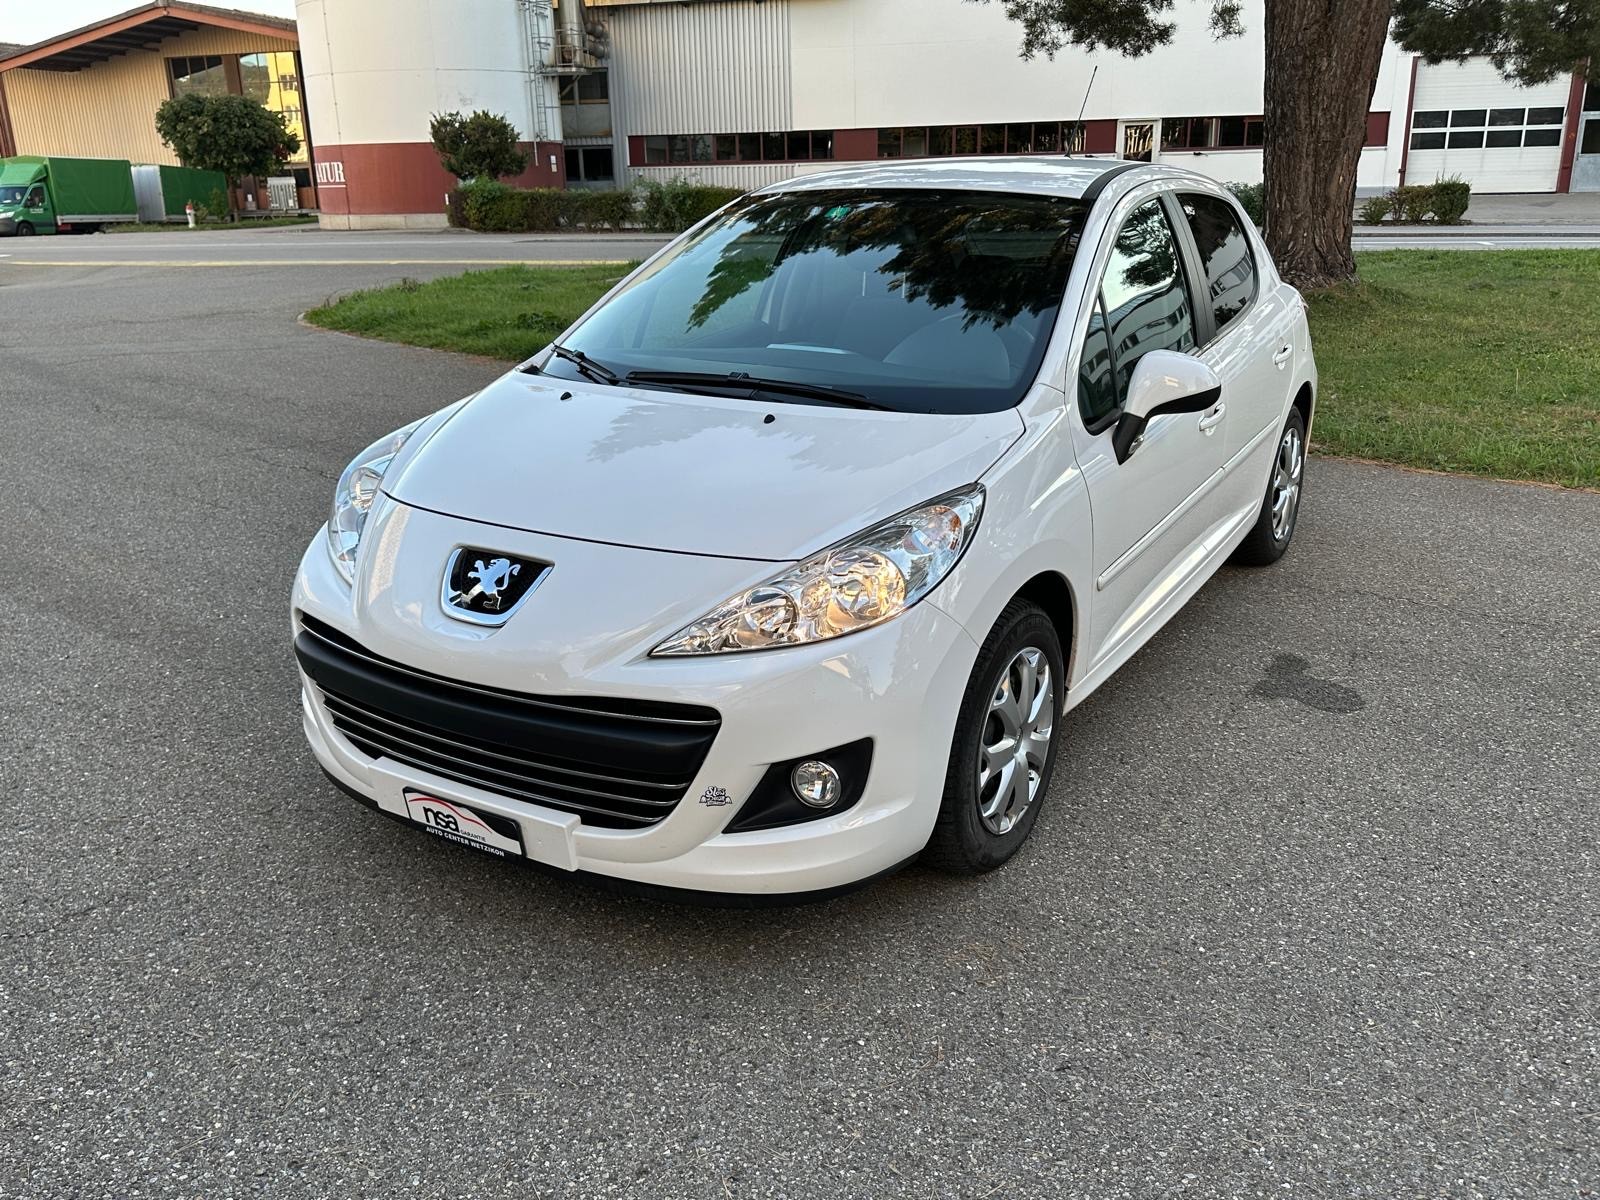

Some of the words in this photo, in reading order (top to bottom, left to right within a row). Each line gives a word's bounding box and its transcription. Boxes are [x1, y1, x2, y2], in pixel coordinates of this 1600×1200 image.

[422, 805, 460, 833] nsa
[426, 826, 443, 836] AUTO
[444, 833, 470, 845] CENTER
[470, 841, 505, 857] WETZIKON
